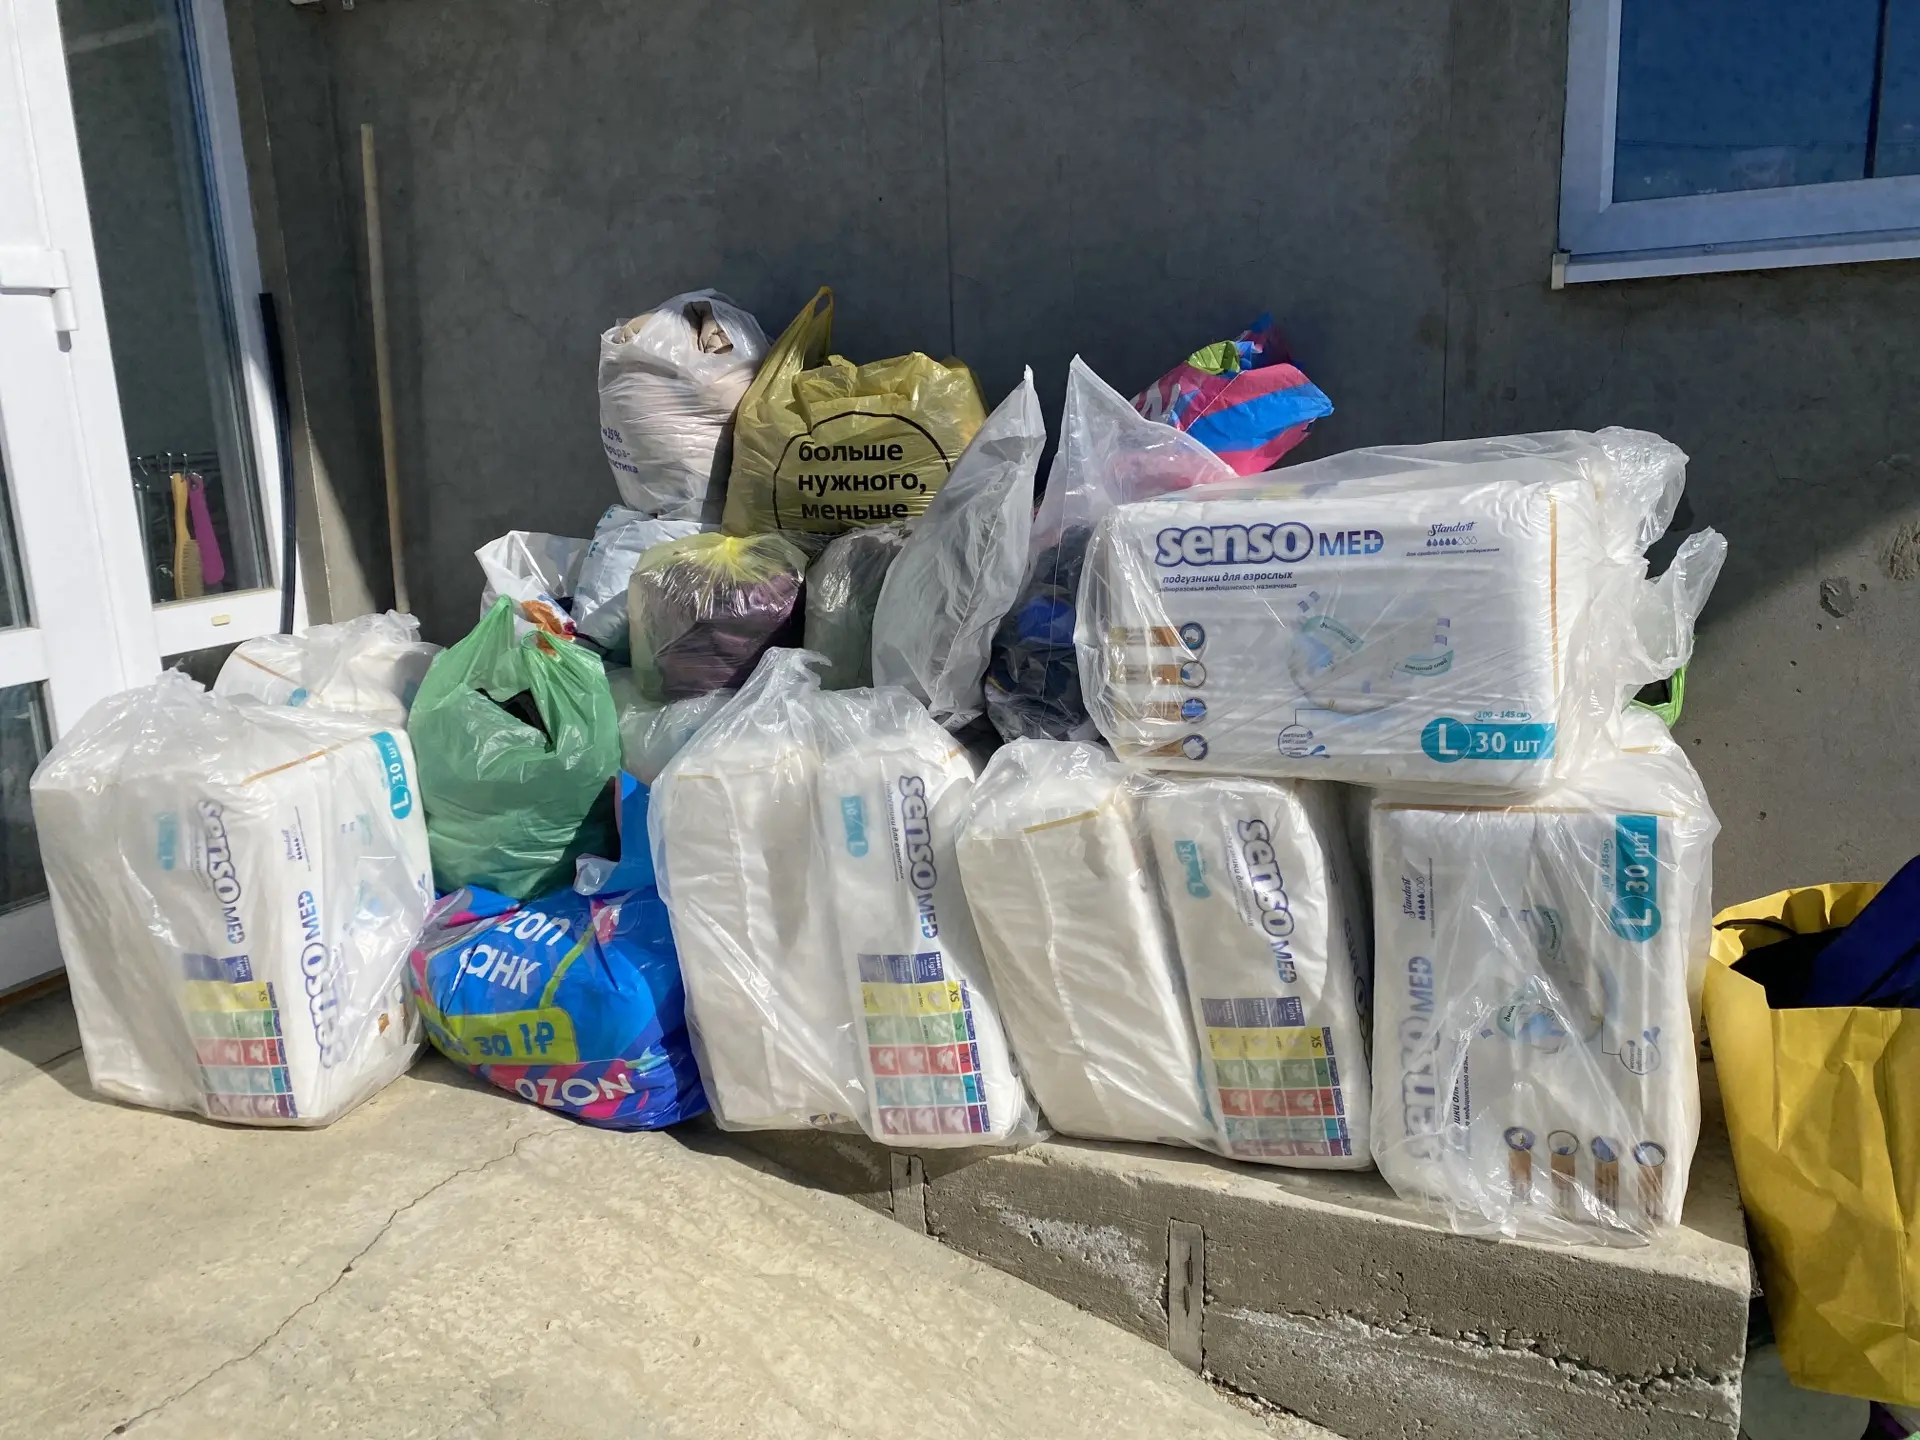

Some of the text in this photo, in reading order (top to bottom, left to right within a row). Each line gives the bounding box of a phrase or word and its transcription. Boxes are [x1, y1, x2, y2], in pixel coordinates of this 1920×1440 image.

[799, 441, 903, 461] больше
[798, 473, 927, 497] нужного,
[801, 503, 909, 520] меньше
[1427, 521, 1478, 536] Standart
[1154, 521, 1385, 567] senso MED
[1162, 571, 1293, 584] подгузники для взрослых
[1438, 723, 1541, 756] L 30 шт
[389, 762, 404, 784] 30
[393, 791, 409, 810] L
[899, 775, 937, 892] senso
[1623, 864, 1649, 893] 30
[1237, 819, 1298, 984] senso MED
[222, 905, 245, 944] MED
[298, 889, 322, 941] MED
[916, 893, 939, 939] MED
[1615, 908, 1652, 927] L
[494, 911, 570, 946] zon
[928, 957, 937, 976] Light
[949, 989, 960, 1003] XS
[1408, 956, 1435, 1013] MED
[1287, 1001, 1297, 1021] Light
[473, 1032, 512, 1057] за
[1310, 1035, 1323, 1049] XS
[514, 1073, 636, 1107] OZON
